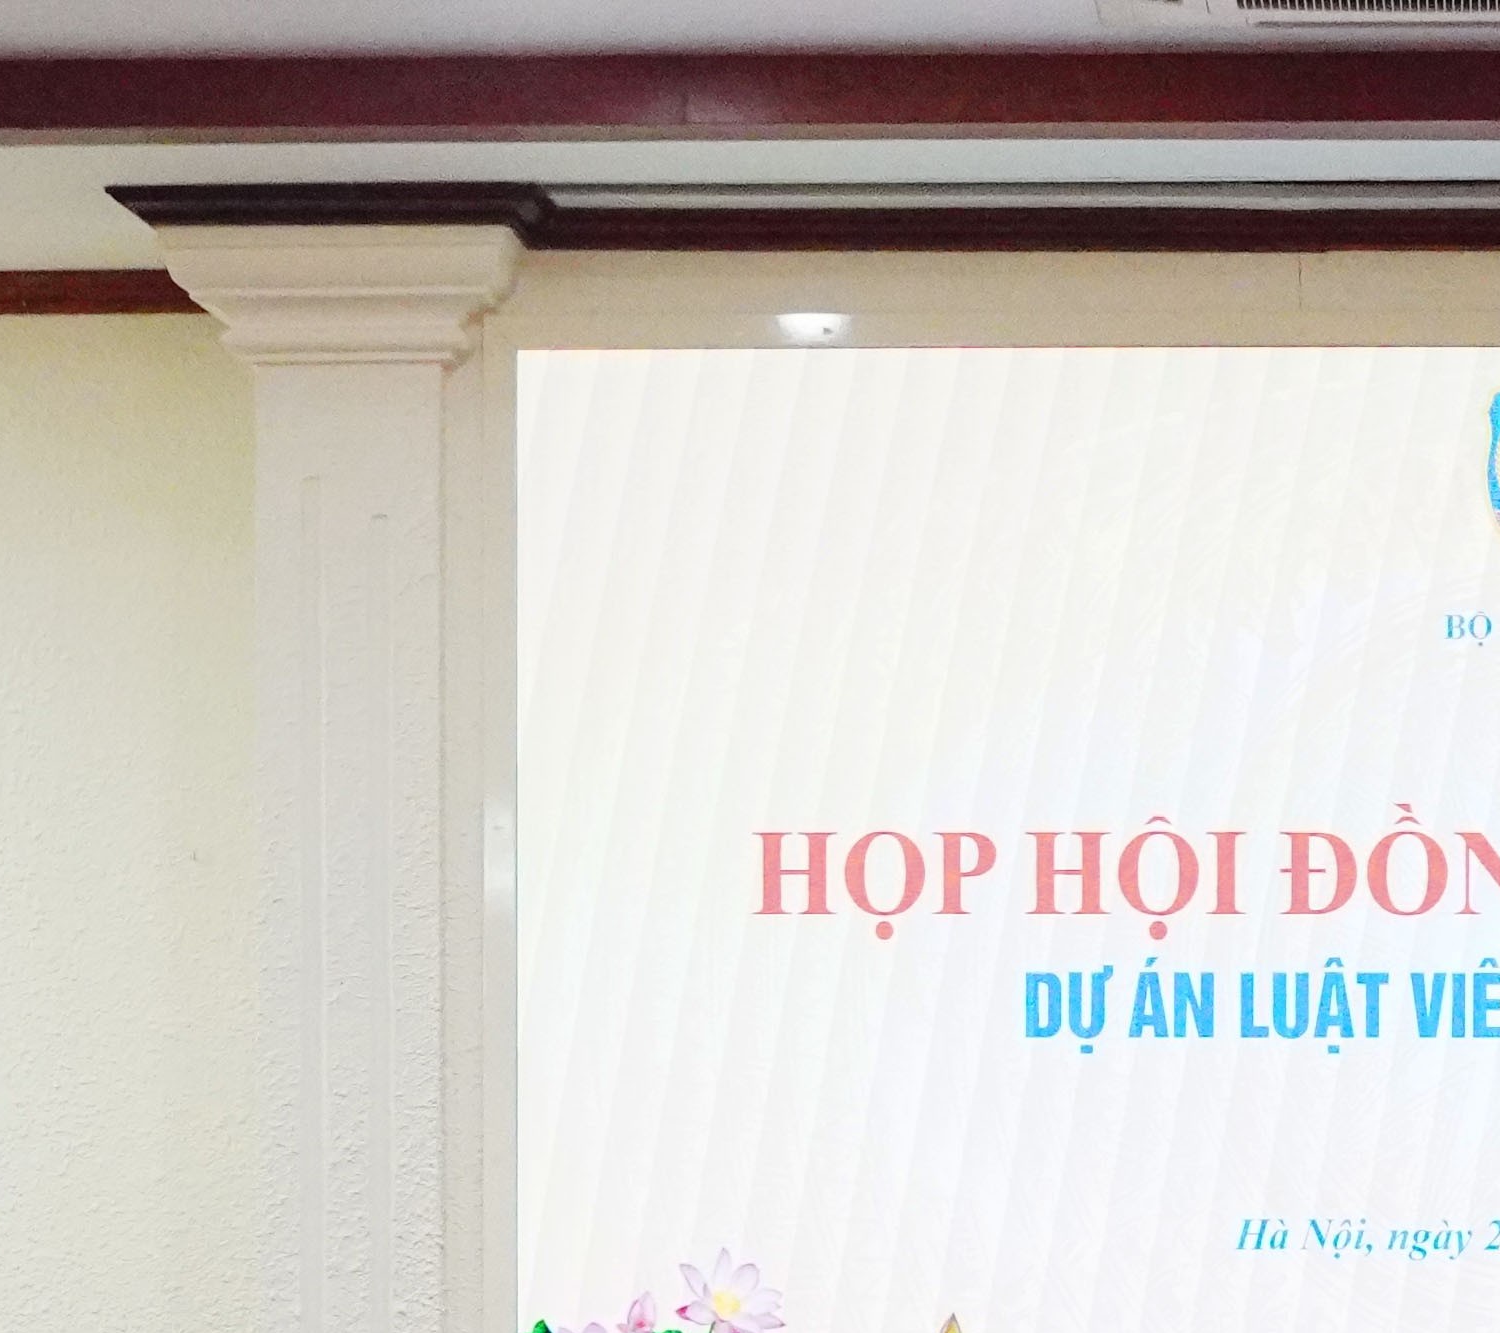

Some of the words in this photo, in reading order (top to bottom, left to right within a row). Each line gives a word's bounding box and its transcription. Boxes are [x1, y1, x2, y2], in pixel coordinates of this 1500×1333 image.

[1444, 610, 1493, 647] BỘ
[751, 830, 997, 941] HỌP
[1025, 815, 1248, 941] HỘI
[1025, 965, 1113, 1054] DỰ
[1128, 956, 1215, 1038] ÁN
[1240, 956, 1390, 1054] LUẬT
[1236, 1217, 1289, 1251] Hà
[1301, 1217, 1374, 1260] Nội,
[1387, 1219, 1473, 1261] ngày
